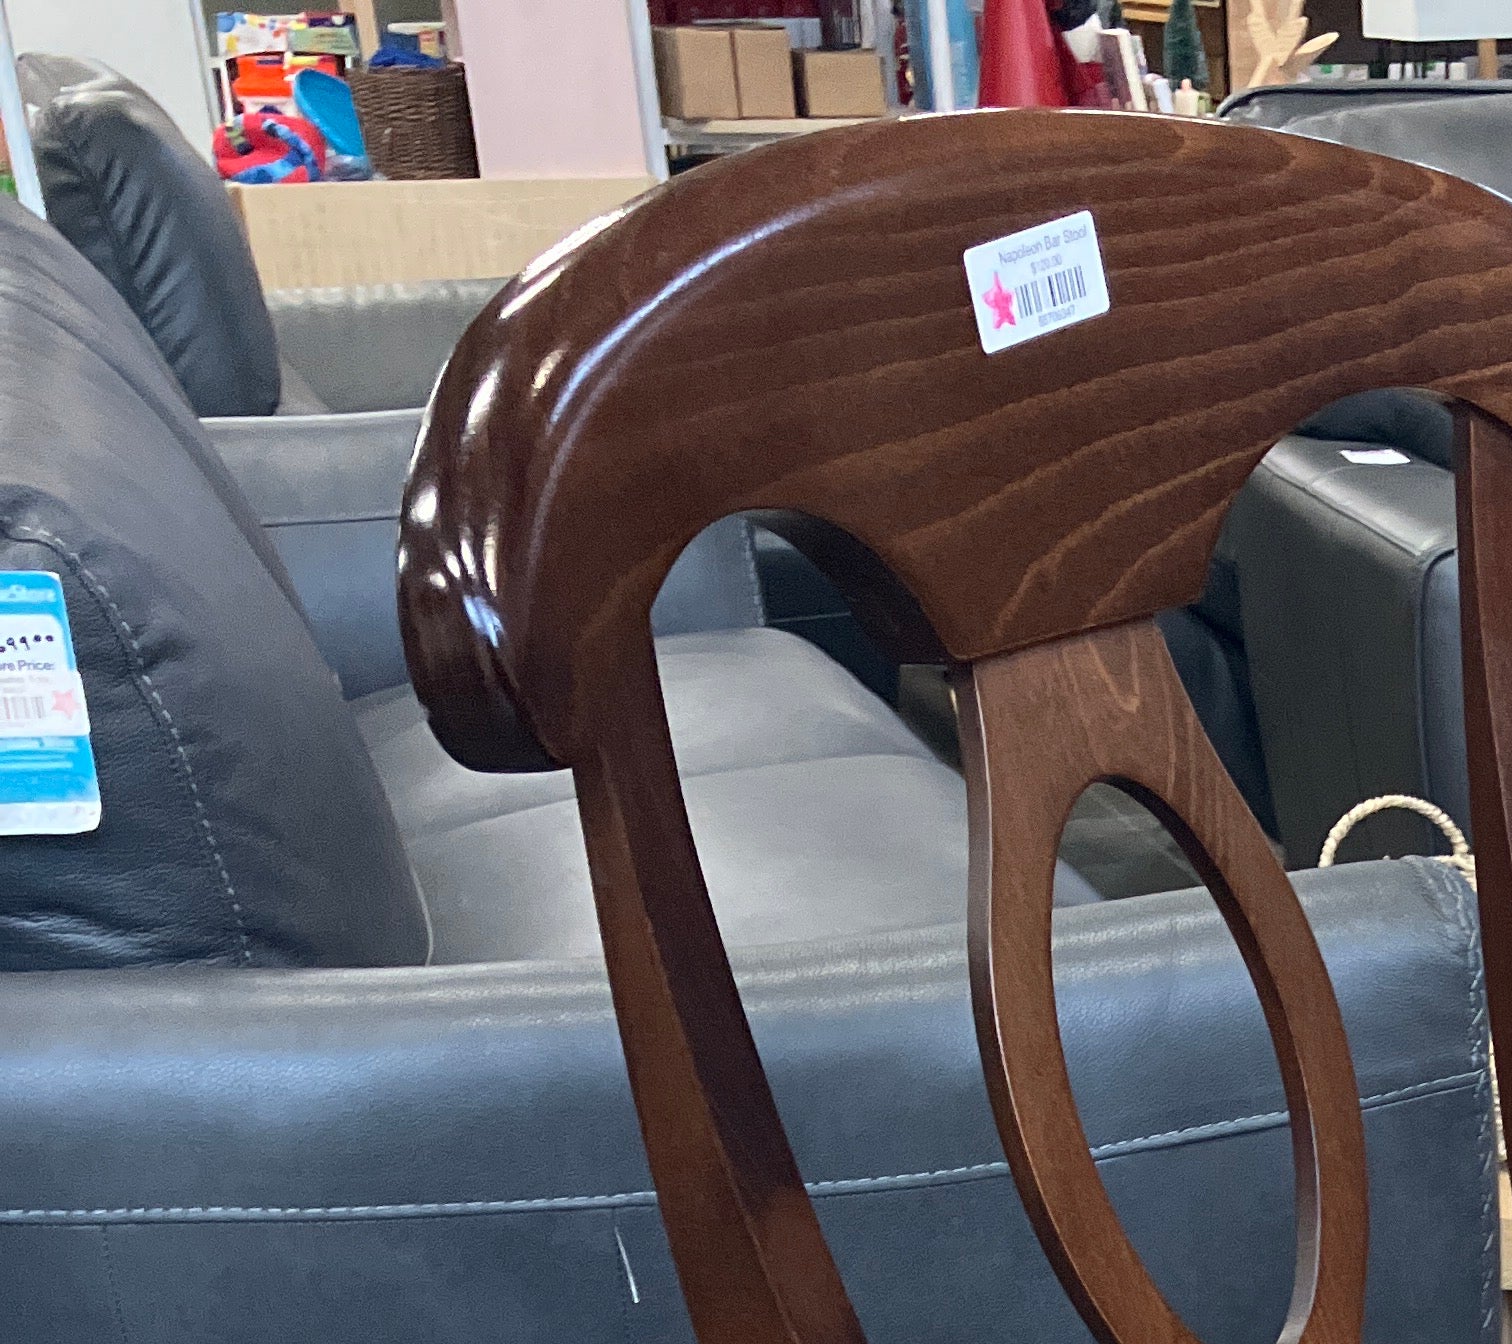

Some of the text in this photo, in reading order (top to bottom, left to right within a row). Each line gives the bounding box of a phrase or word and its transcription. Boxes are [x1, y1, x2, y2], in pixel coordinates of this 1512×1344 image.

[998, 224, 1088, 265] Napoleon Bar Stool
[17, 659, 55, 671] Price:
